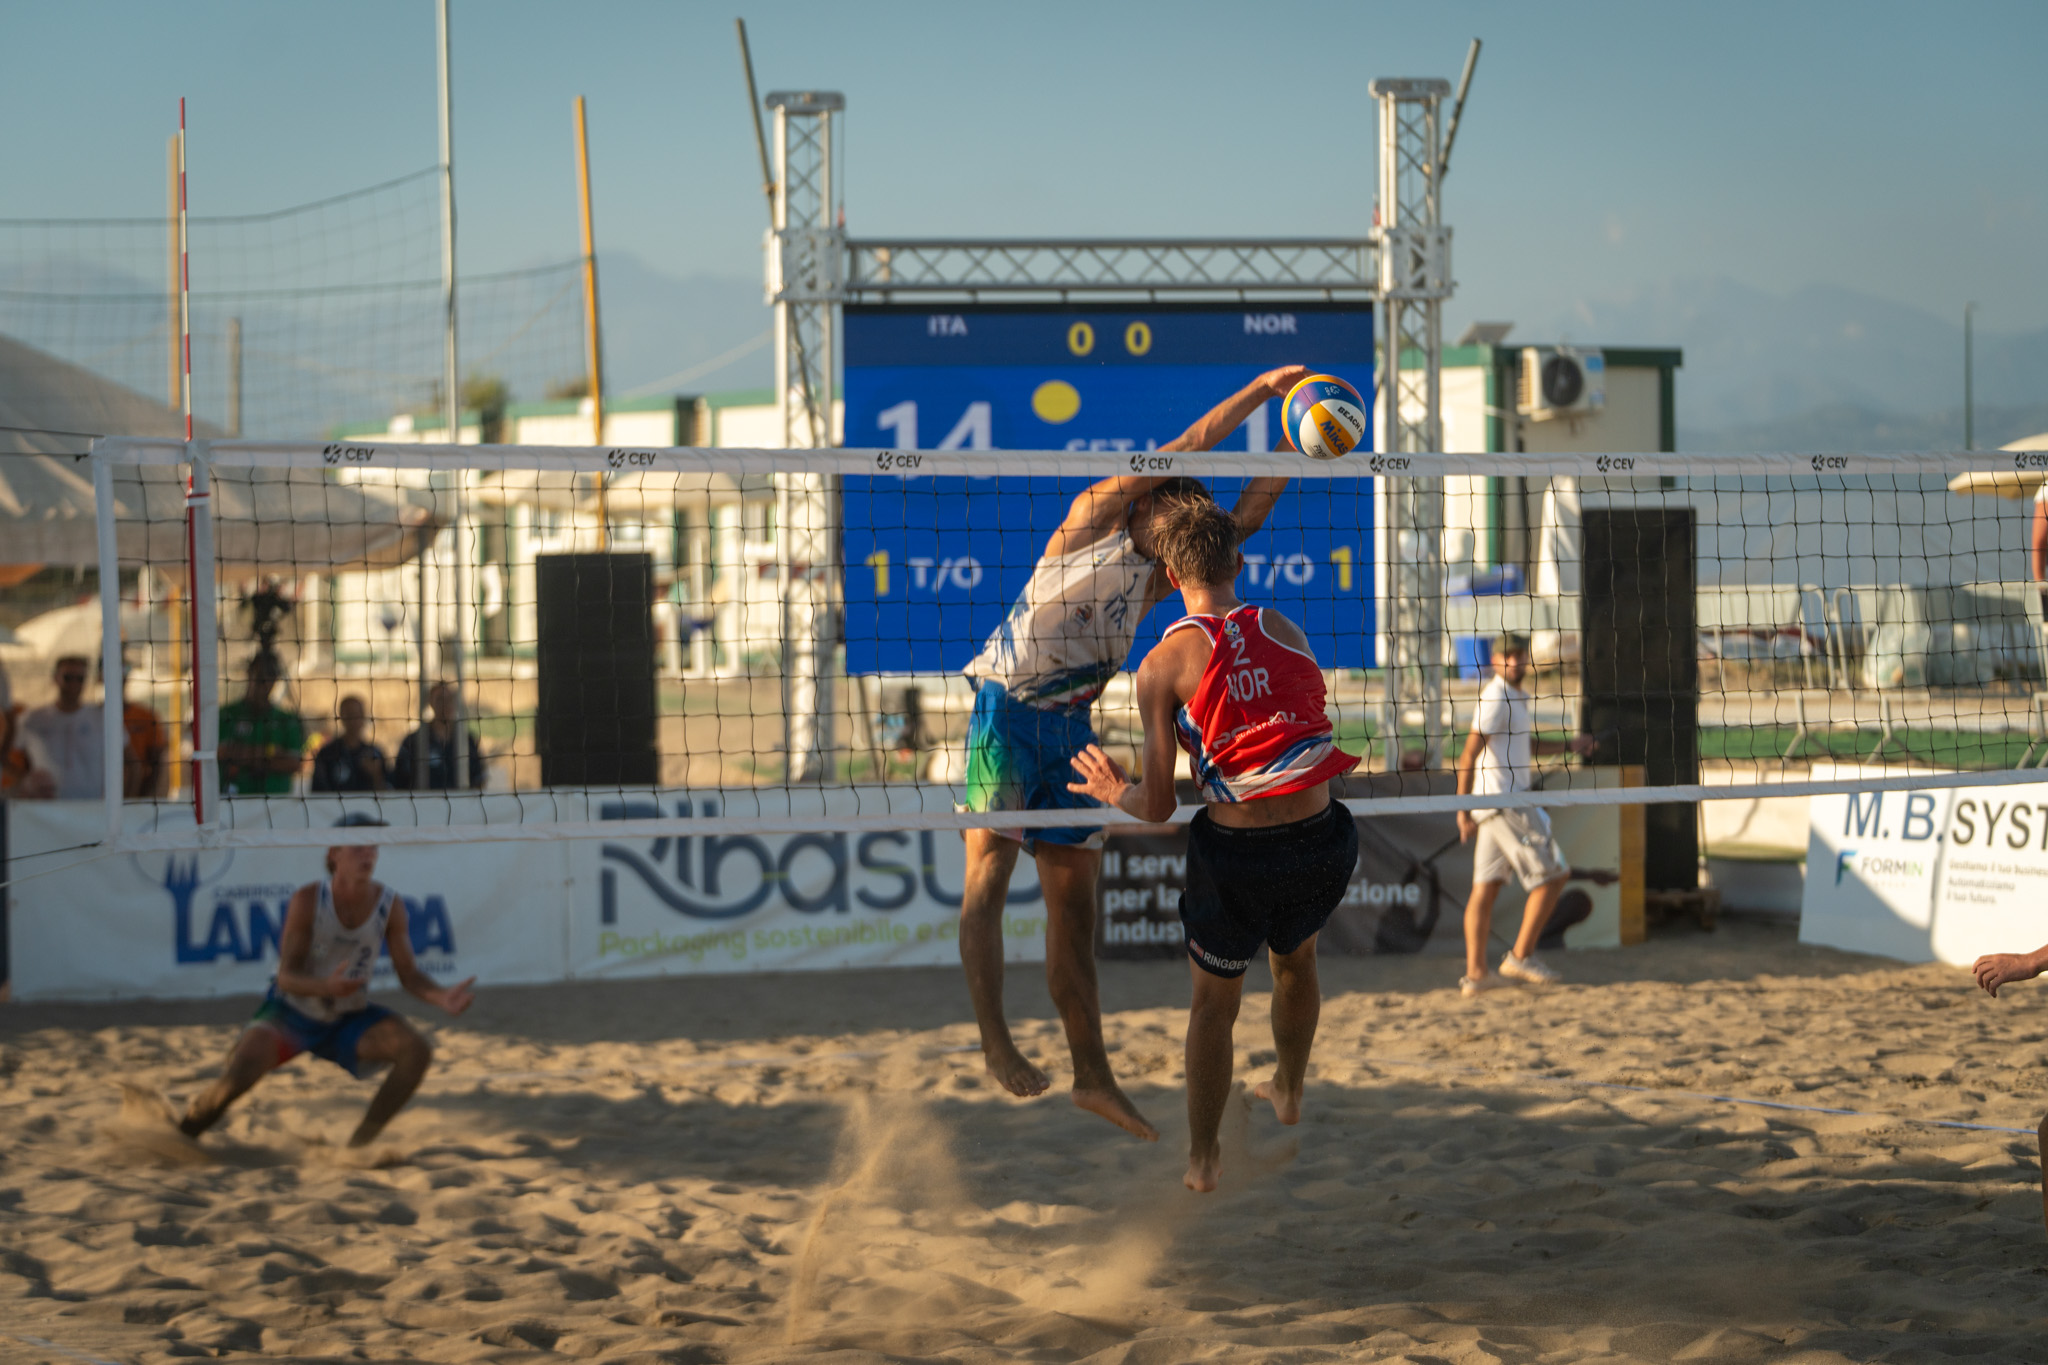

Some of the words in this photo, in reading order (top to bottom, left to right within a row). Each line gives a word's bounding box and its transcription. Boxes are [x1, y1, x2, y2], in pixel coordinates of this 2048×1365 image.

[928, 316, 968, 336] ITA
[1243, 314, 1298, 334] NOR
[1067, 321, 1094, 356] 0
[1125, 320, 1152, 355] 0
[1337, 406, 1361, 430] BEACH
[877, 400, 1000, 480] 14
[346, 448, 375, 461] CEV
[629, 452, 657, 465] CEV
[896, 455, 922, 468] CEV
[1148, 457, 1173, 470] CEV
[1387, 458, 1410, 470] CEV
[1613, 458, 1635, 470] CEV
[1827, 457, 1848, 469] CEV
[2030, 455, 2048, 466] CEV
[865, 550, 889, 596] 1
[909, 557, 983, 593] T/O
[1243, 554, 1315, 589] T/O
[1331, 546, 1352, 592] 1
[1231, 637, 1250, 667] 2
[1226, 667, 1272, 704] NOR
[1127, 854, 1187, 879] serv
[1103, 887, 1152, 916] per
[1156, 882, 1181, 911] la
[1340, 878, 1421, 908] zione
[600, 928, 747, 961] Packaging
[1203, 951, 1251, 970] RINGØEN
